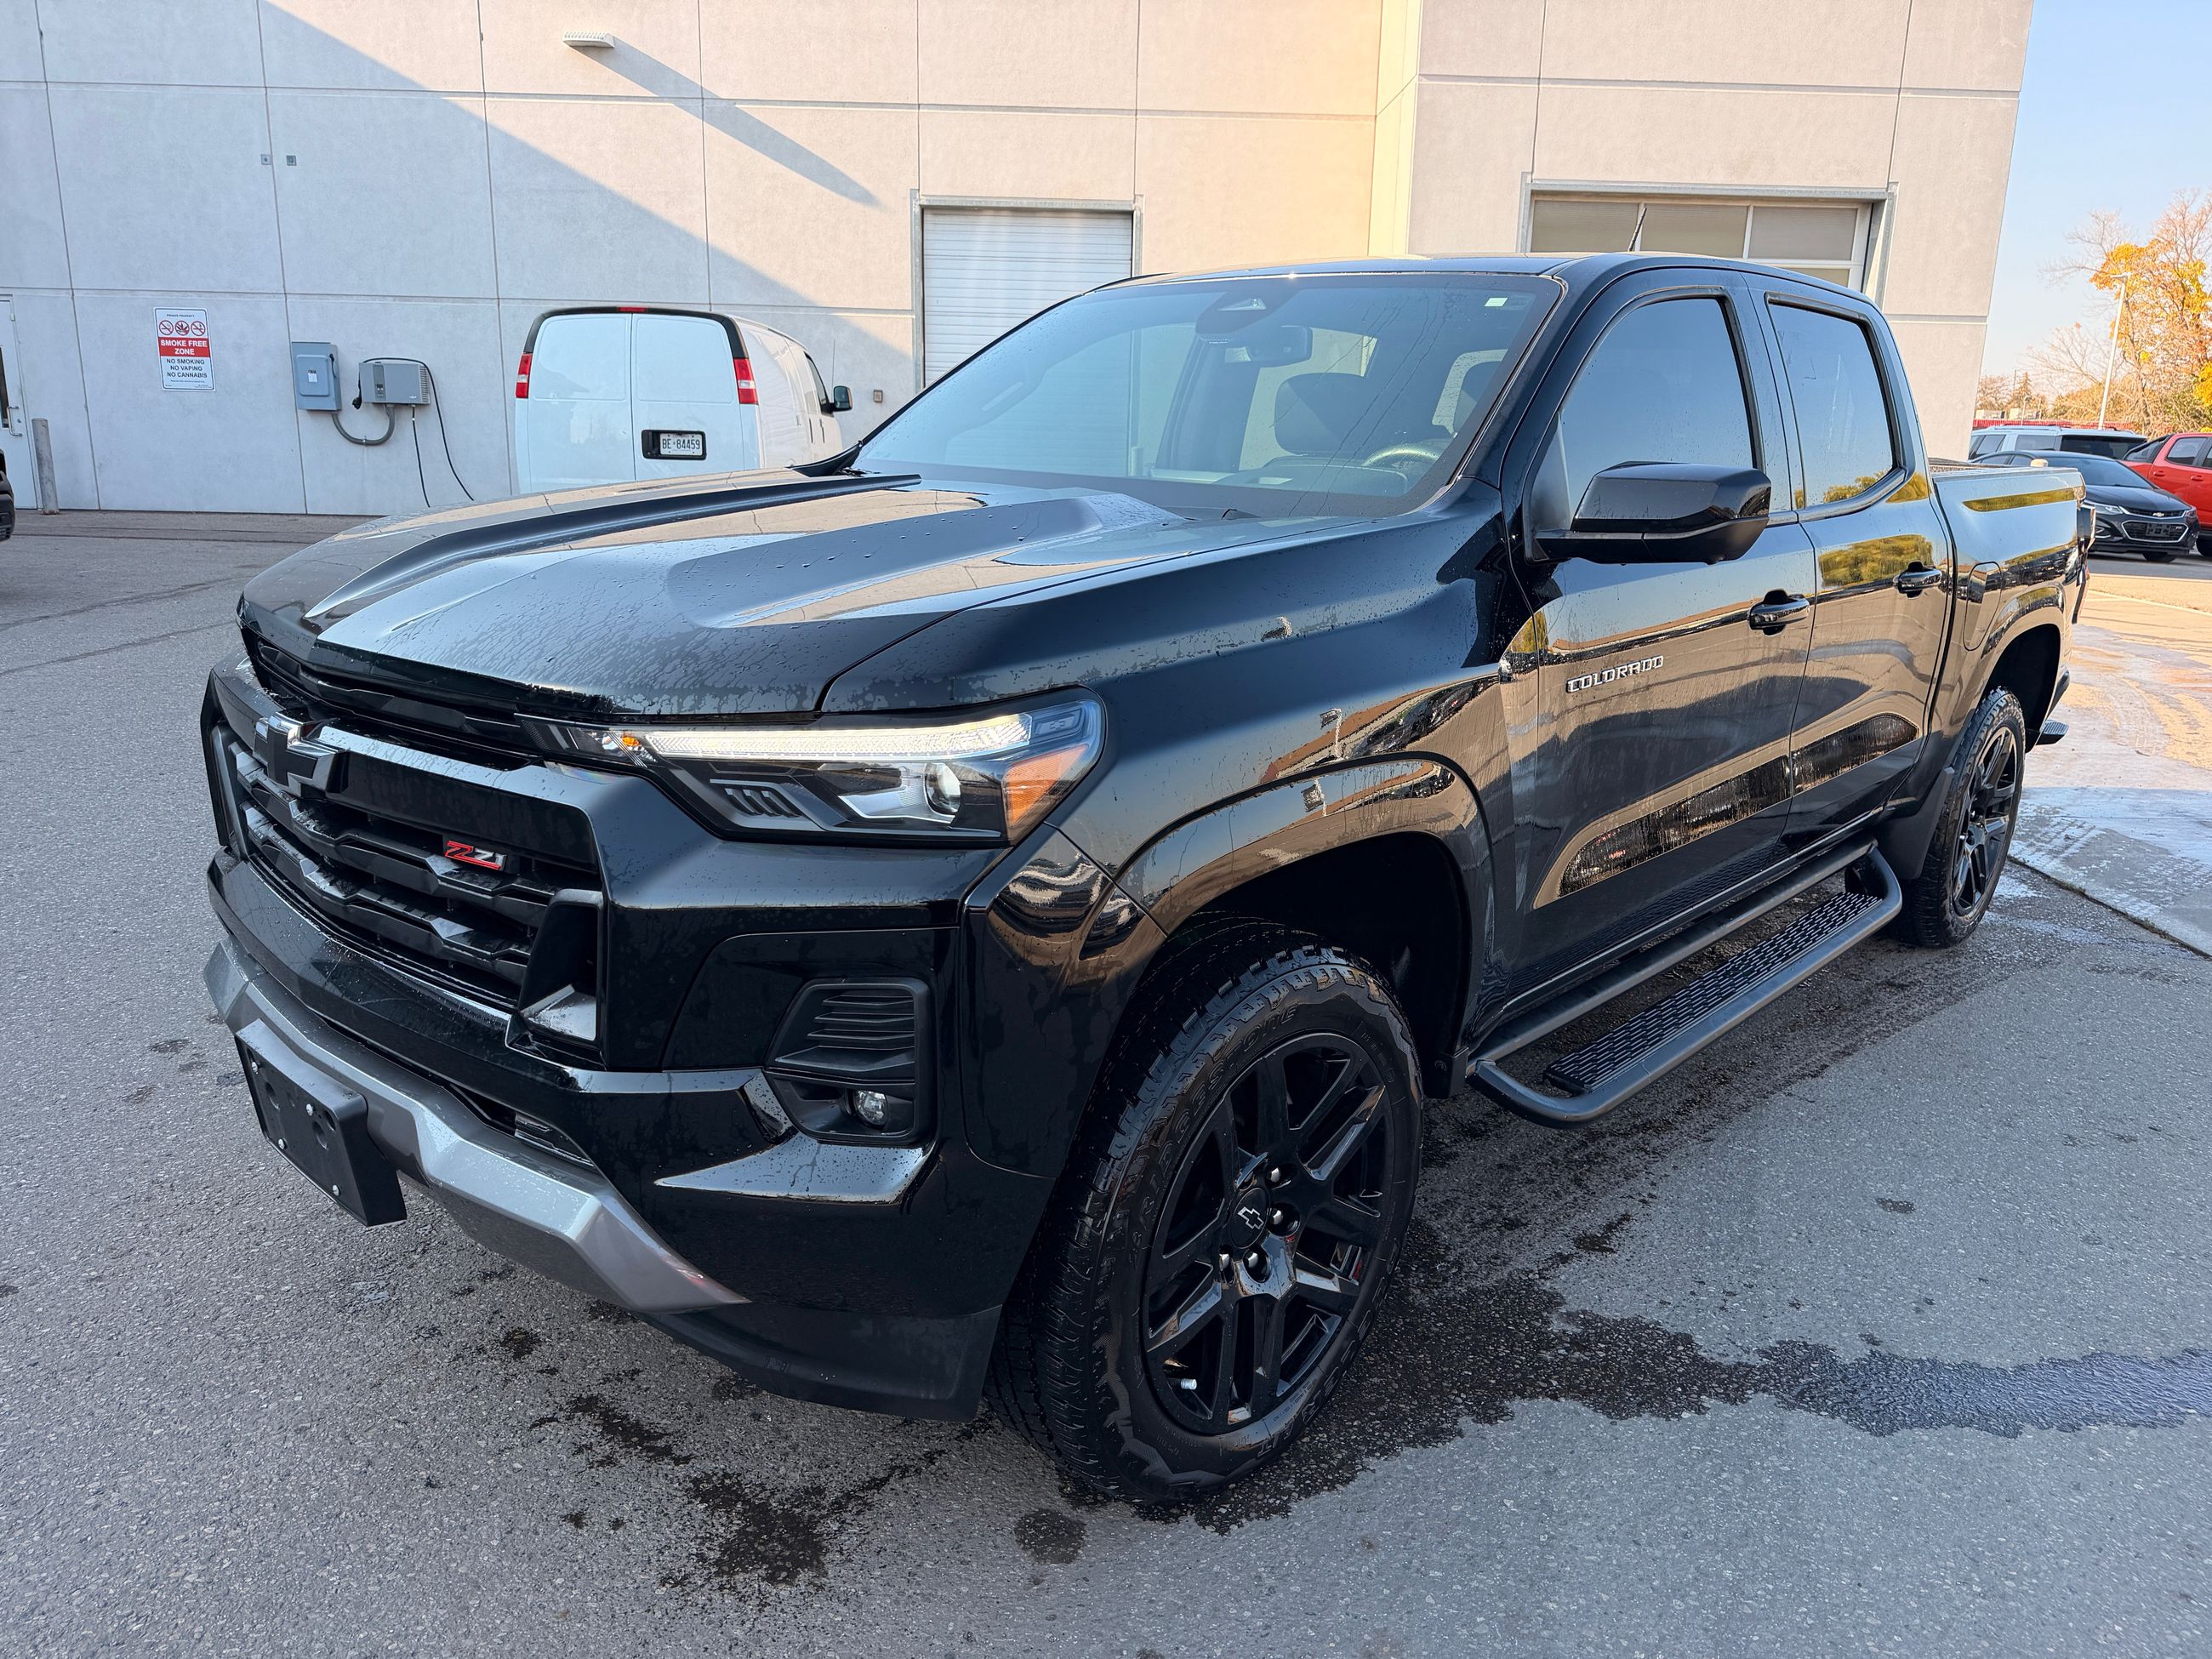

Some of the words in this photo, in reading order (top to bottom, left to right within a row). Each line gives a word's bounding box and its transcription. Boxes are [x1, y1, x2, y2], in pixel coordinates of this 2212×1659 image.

[676, 439, 700, 449] 84459
[1566, 655, 1664, 693] COLORADO
[444, 840, 507, 871] Z71
